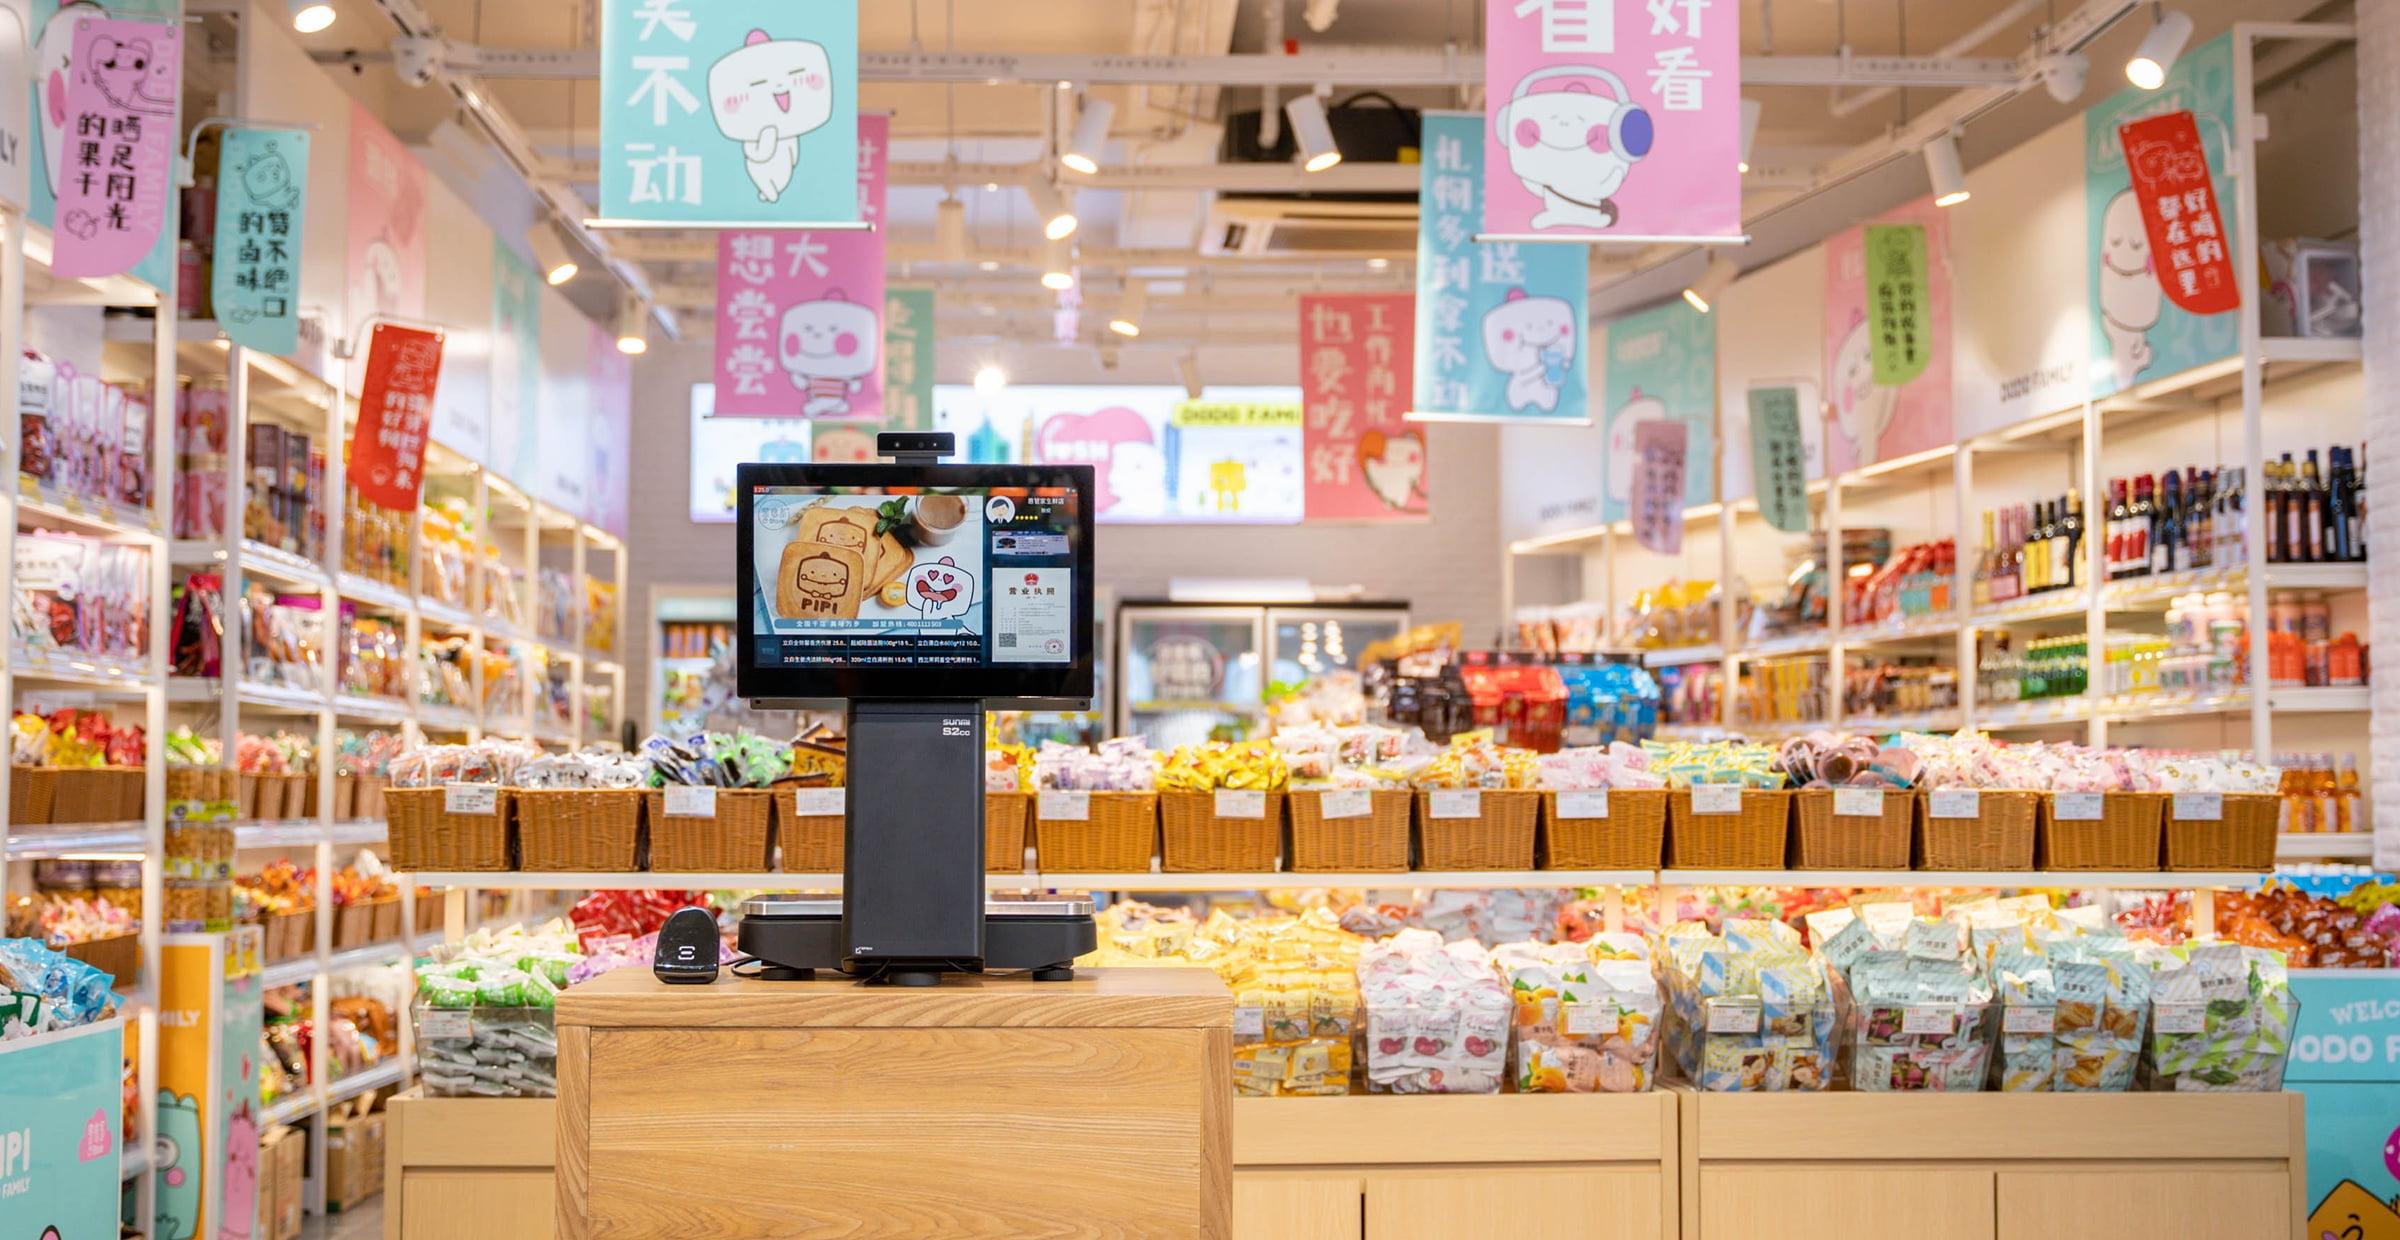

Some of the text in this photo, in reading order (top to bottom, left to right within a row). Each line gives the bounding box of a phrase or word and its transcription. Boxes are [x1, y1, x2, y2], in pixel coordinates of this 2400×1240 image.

[75, 112, 107, 197] 的果干
[106, 115, 141, 232] 晒足阳光
[235, 211, 264, 293] 的卤味
[263, 211, 290, 318] 赞不绝口
[785, 234, 829, 278] 大
[2158, 193, 2201, 297] 都在这里
[2184, 187, 2223, 265] 好喝的
[726, 234, 776, 396] 想尝尝
[1308, 302, 1355, 486] 也要吃好
[801, 598, 838, 615] PIPI
[1009, 587, 1055, 596] 营业执照
[2, 1176, 31, 1200] FAMILY
